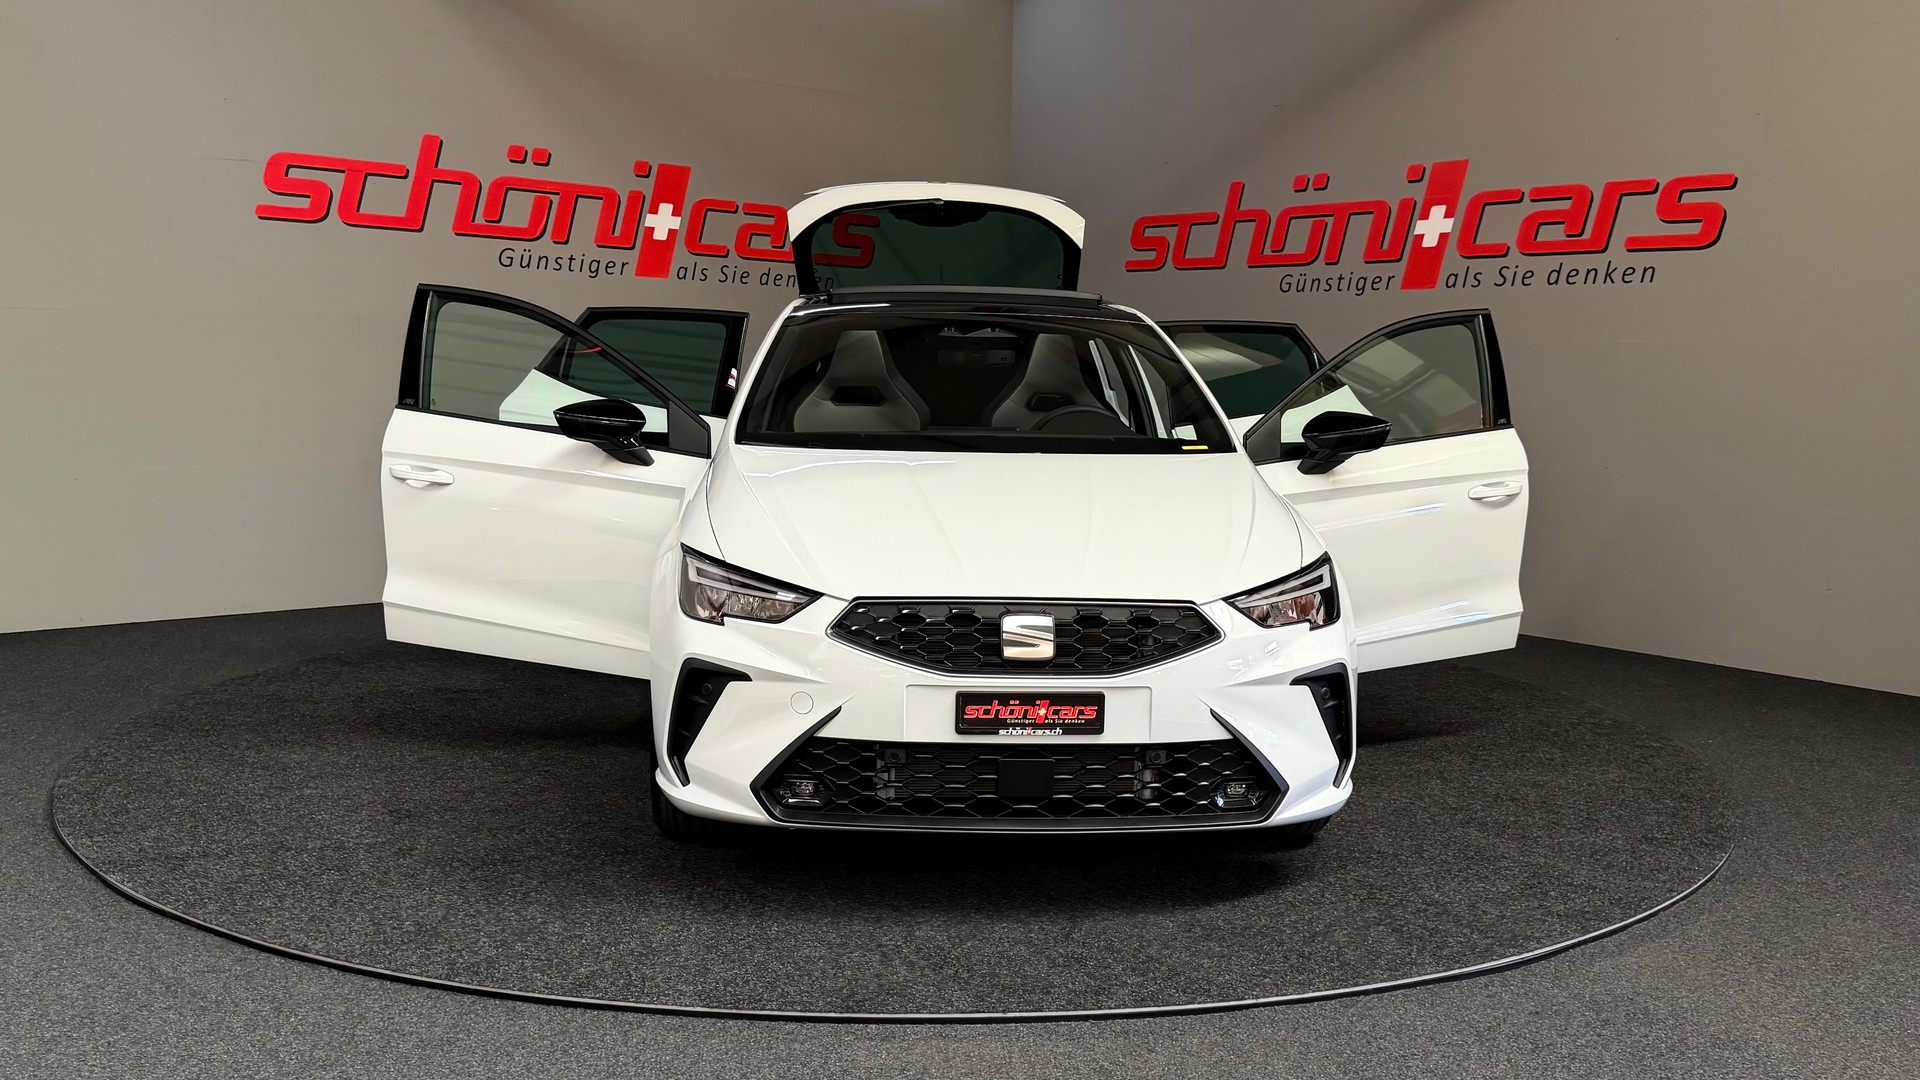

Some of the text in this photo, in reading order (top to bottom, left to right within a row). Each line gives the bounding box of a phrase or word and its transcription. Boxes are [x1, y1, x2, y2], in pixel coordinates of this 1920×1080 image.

[683, 197, 882, 270] cas
[498, 247, 834, 291] Günstiger als Sie denen
[1278, 261, 1657, 297] Günstiger als Sie denken
